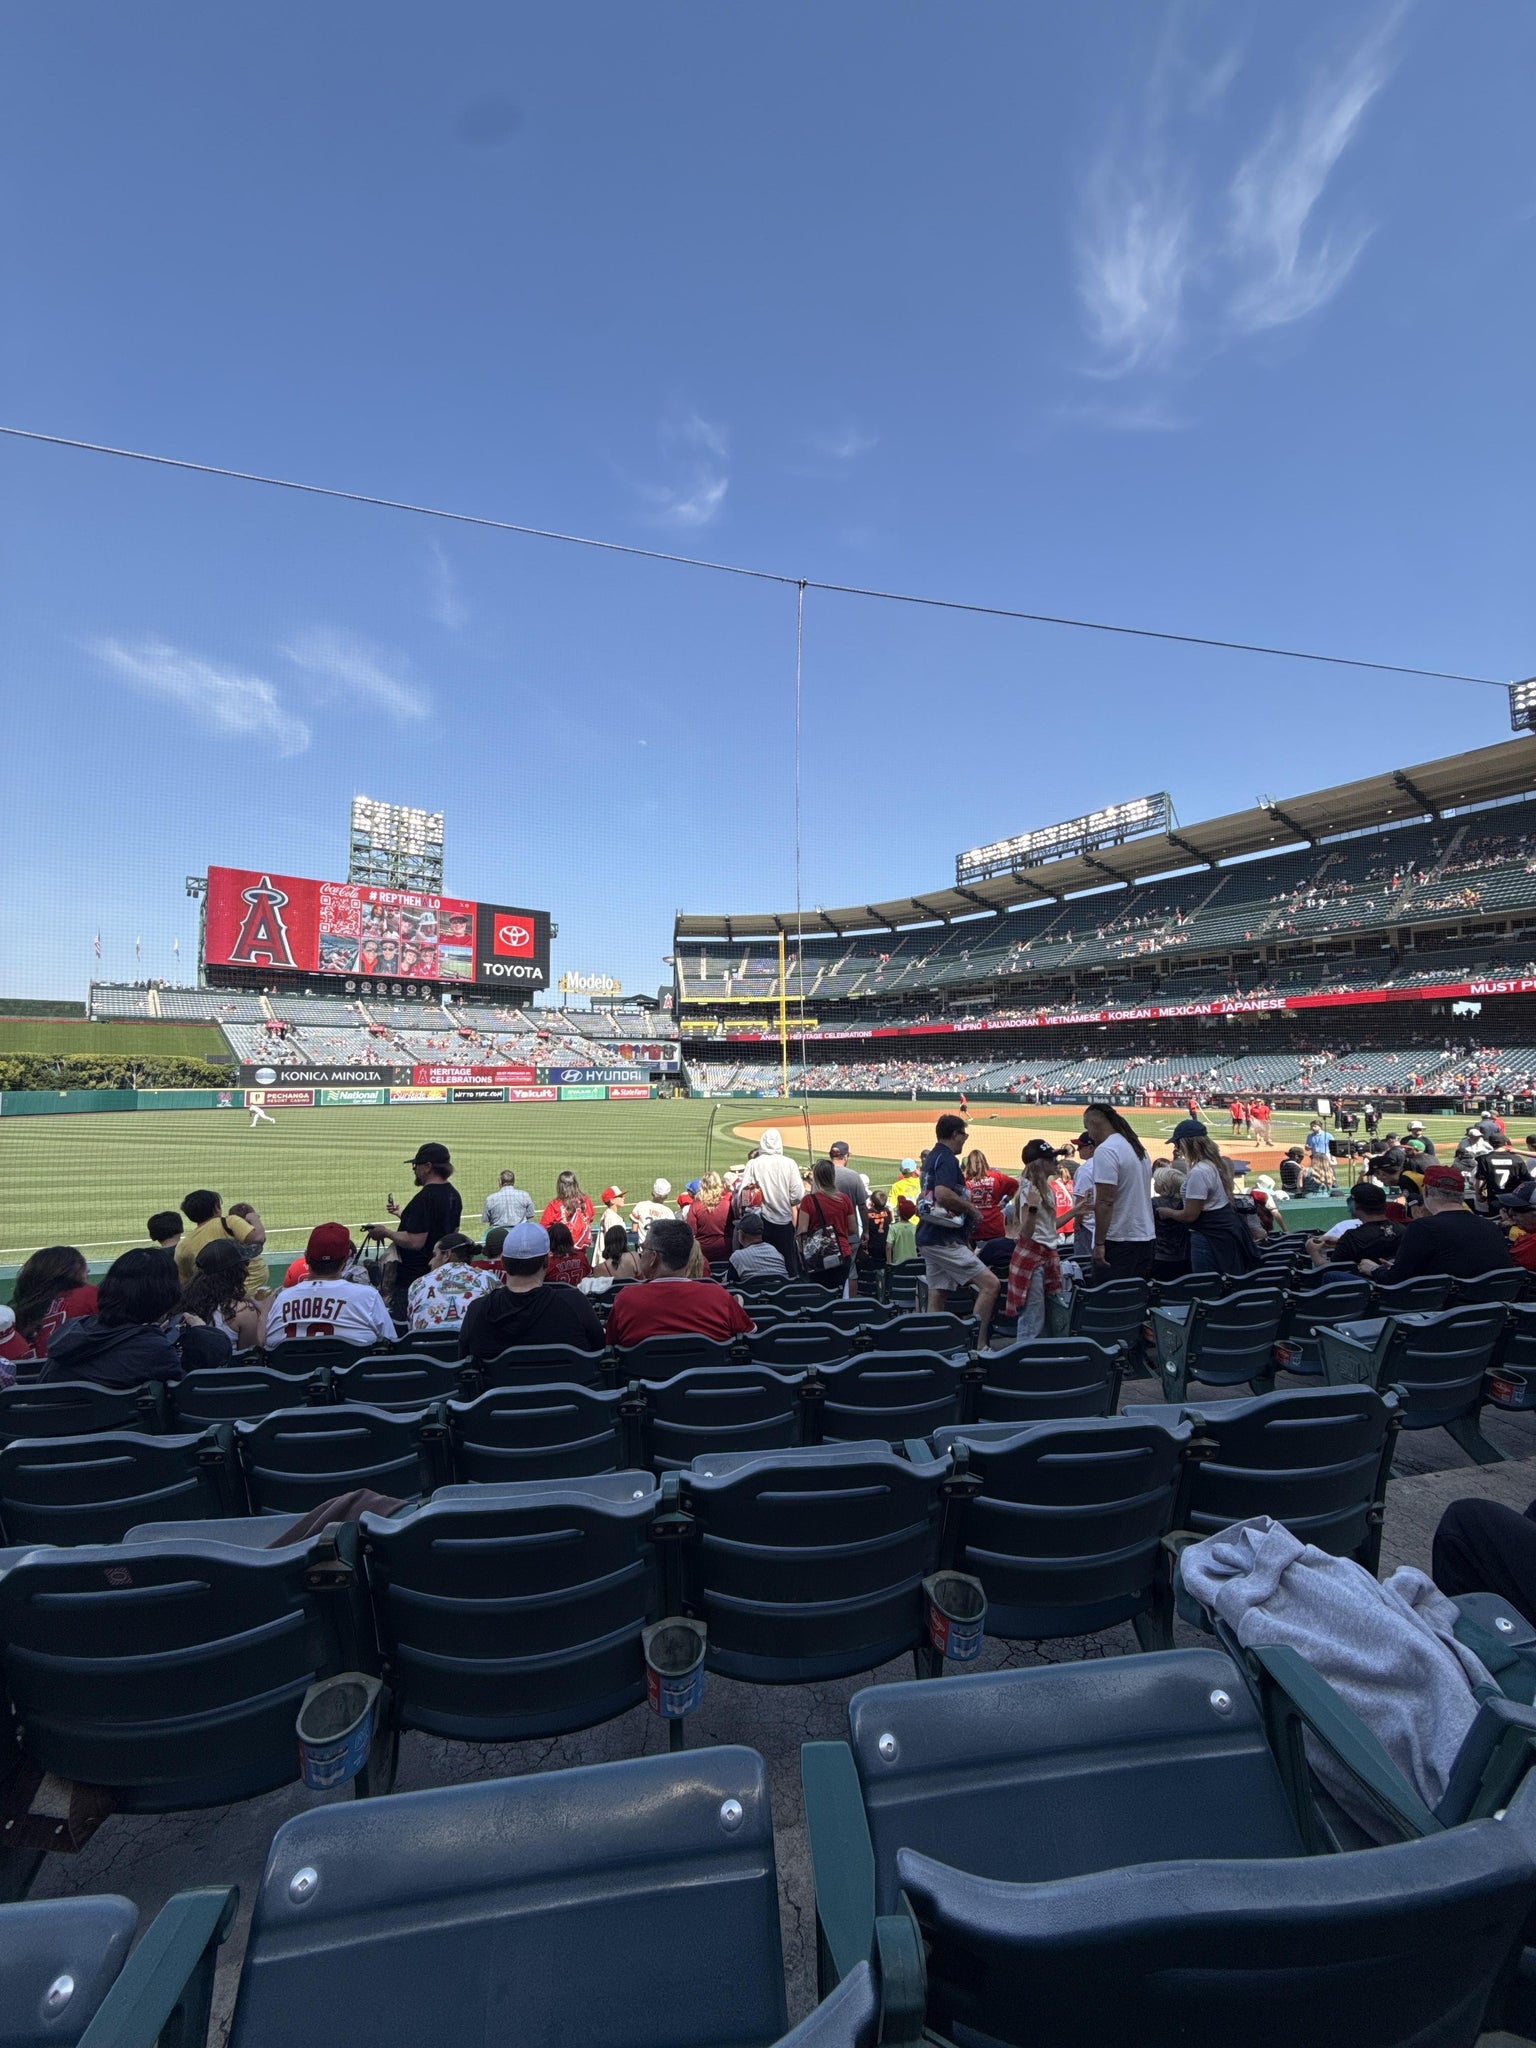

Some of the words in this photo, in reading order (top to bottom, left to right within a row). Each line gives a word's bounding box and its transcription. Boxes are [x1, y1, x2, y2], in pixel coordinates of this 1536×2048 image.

[482, 962, 543, 979] TOYOTA
[566, 971, 614, 990] Modelo
[1470, 981, 1517, 994] MUST
[1521, 980, 1536, 991] P
[953, 1022, 983, 1031] FILIPINO
[987, 1018, 1039, 1029] SALVADORAN
[1045, 1012, 1101, 1024] VIETNAMESE
[1108, 1010, 1151, 1020] KOREAN
[1159, 1004, 1212, 1017] MEXICAN
[1219, 998, 1287, 1012] JAPANESE
[824, 1030, 873, 1039] CELEBRATIONS
[281, 1071, 328, 1081] KONICA
[331, 1071, 382, 1081] MINOLTA
[430, 1068, 471, 1076] HERITAGE
[586, 1070, 642, 1082] HYUNDAI
[430, 1076, 493, 1084] CELEBRATIONS
[339, 1090, 379, 1100] National
[513, 1089, 554, 1098] Yakult
[1495, 1169, 1510, 1190] 7
[282, 1296, 347, 1322] PROBST
